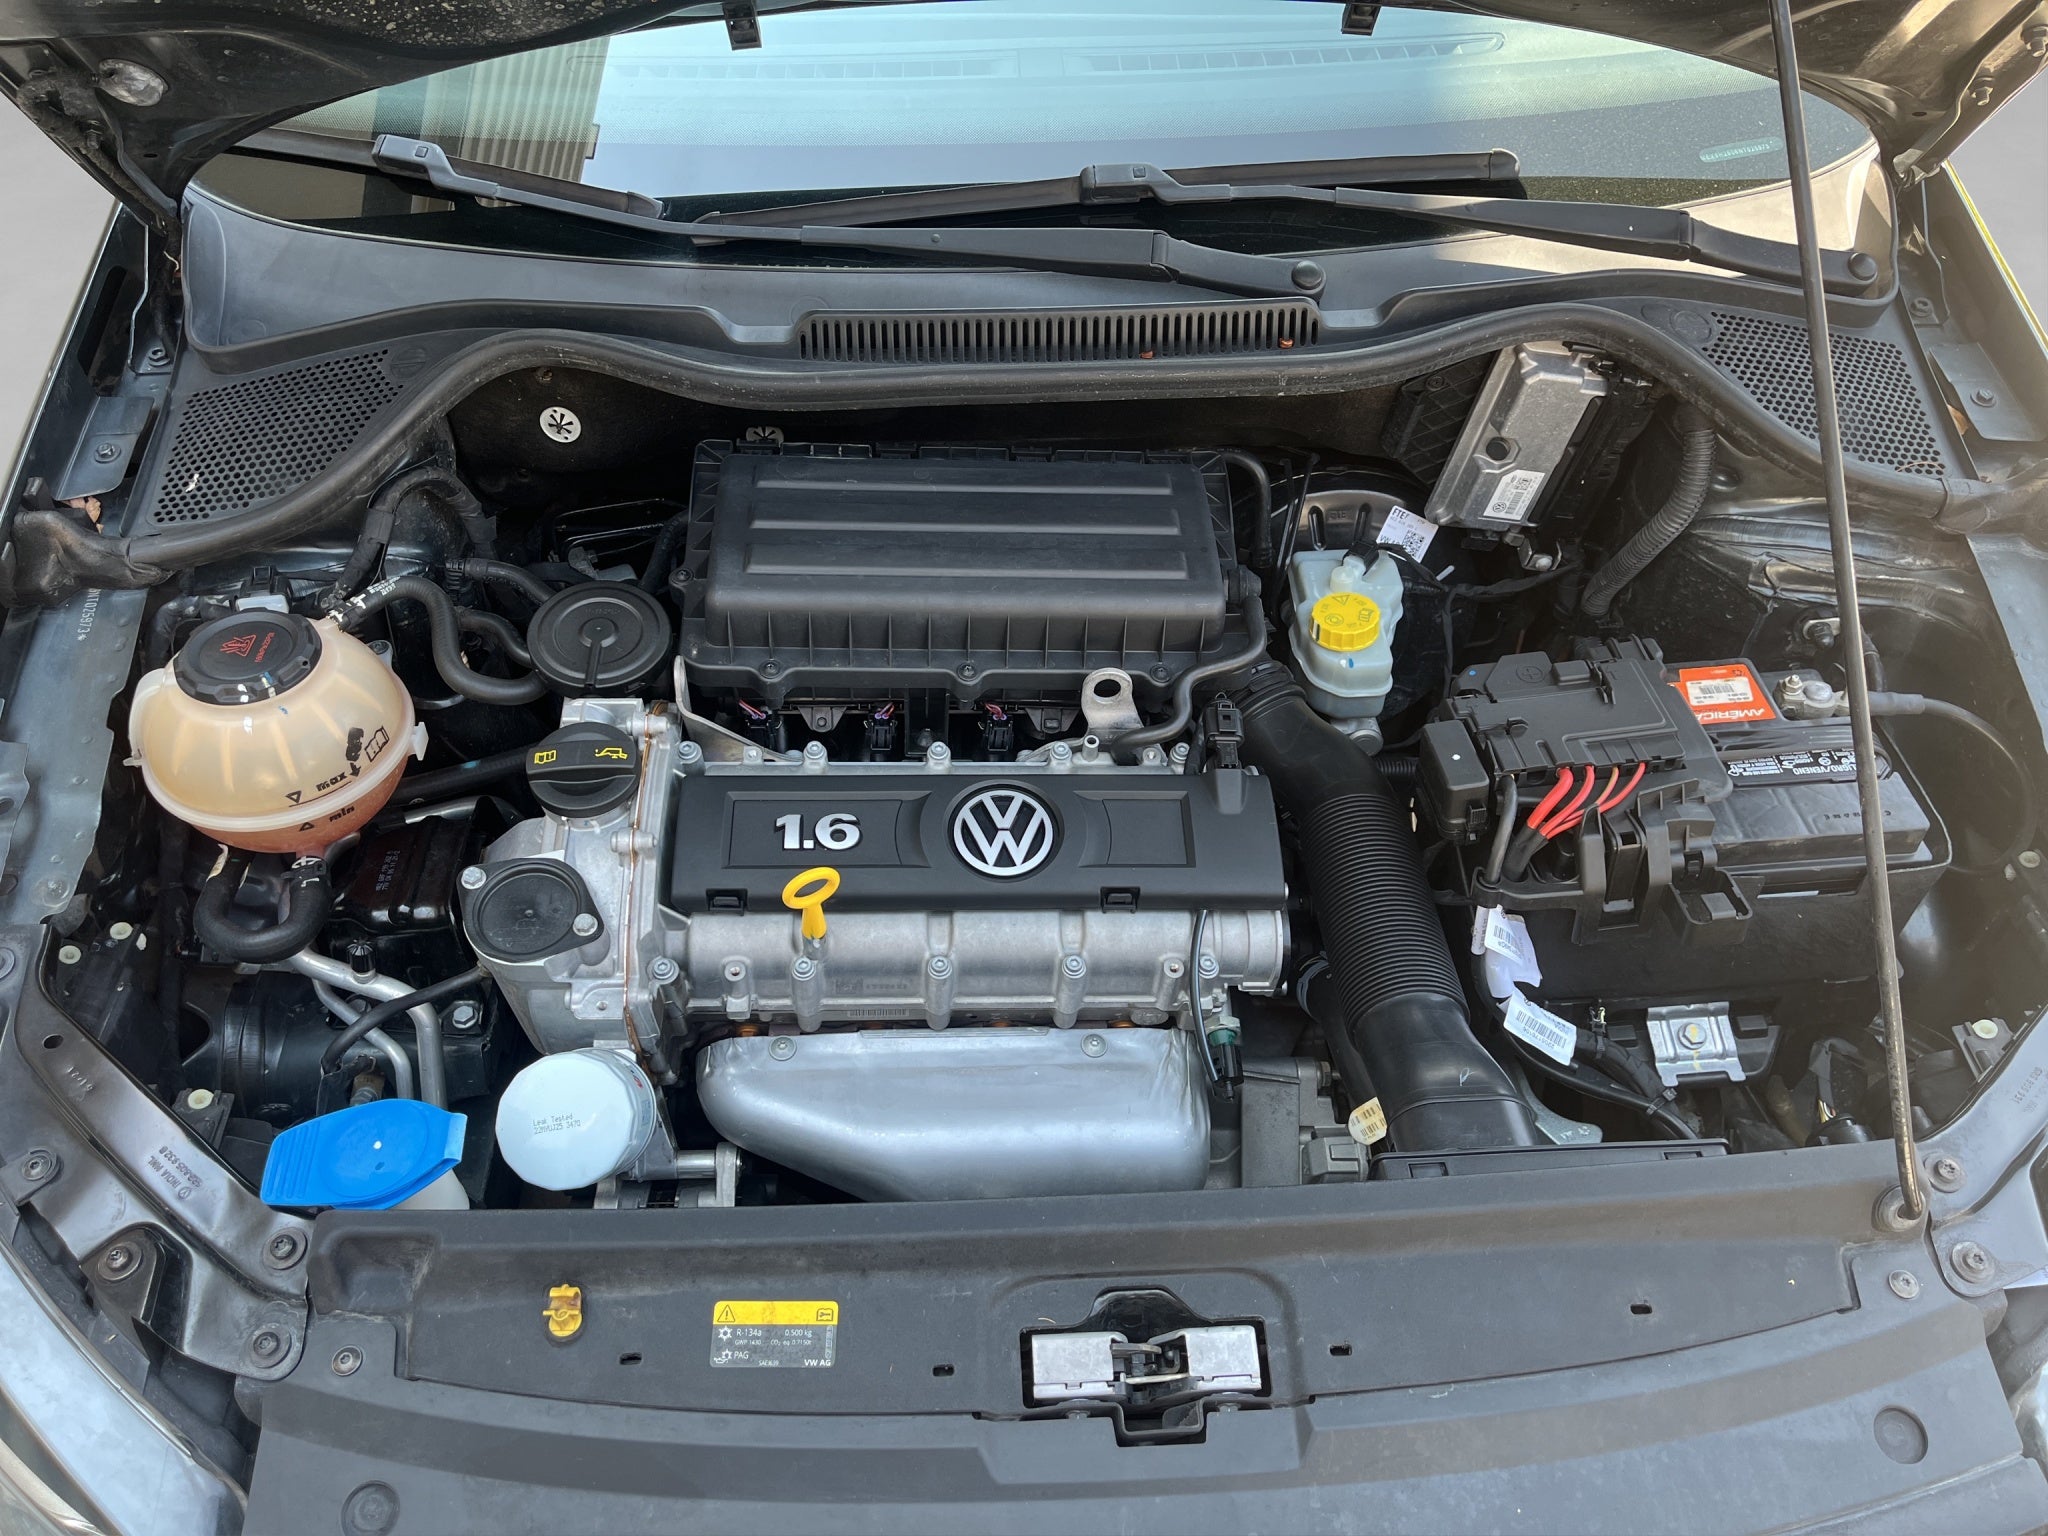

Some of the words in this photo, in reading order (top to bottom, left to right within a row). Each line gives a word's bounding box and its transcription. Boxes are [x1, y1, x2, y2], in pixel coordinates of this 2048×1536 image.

[316, 772, 347, 791] max
[329, 806, 355, 822] min
[775, 813, 862, 851] 1.6
[953, 789, 1053, 876] VW
[551, 1112, 573, 1123] Tested
[736, 1328, 762, 1336] R-134a
[804, 1328, 813, 1338] kg
[733, 1351, 749, 1360] PAG
[819, 1359, 832, 1367] AG
